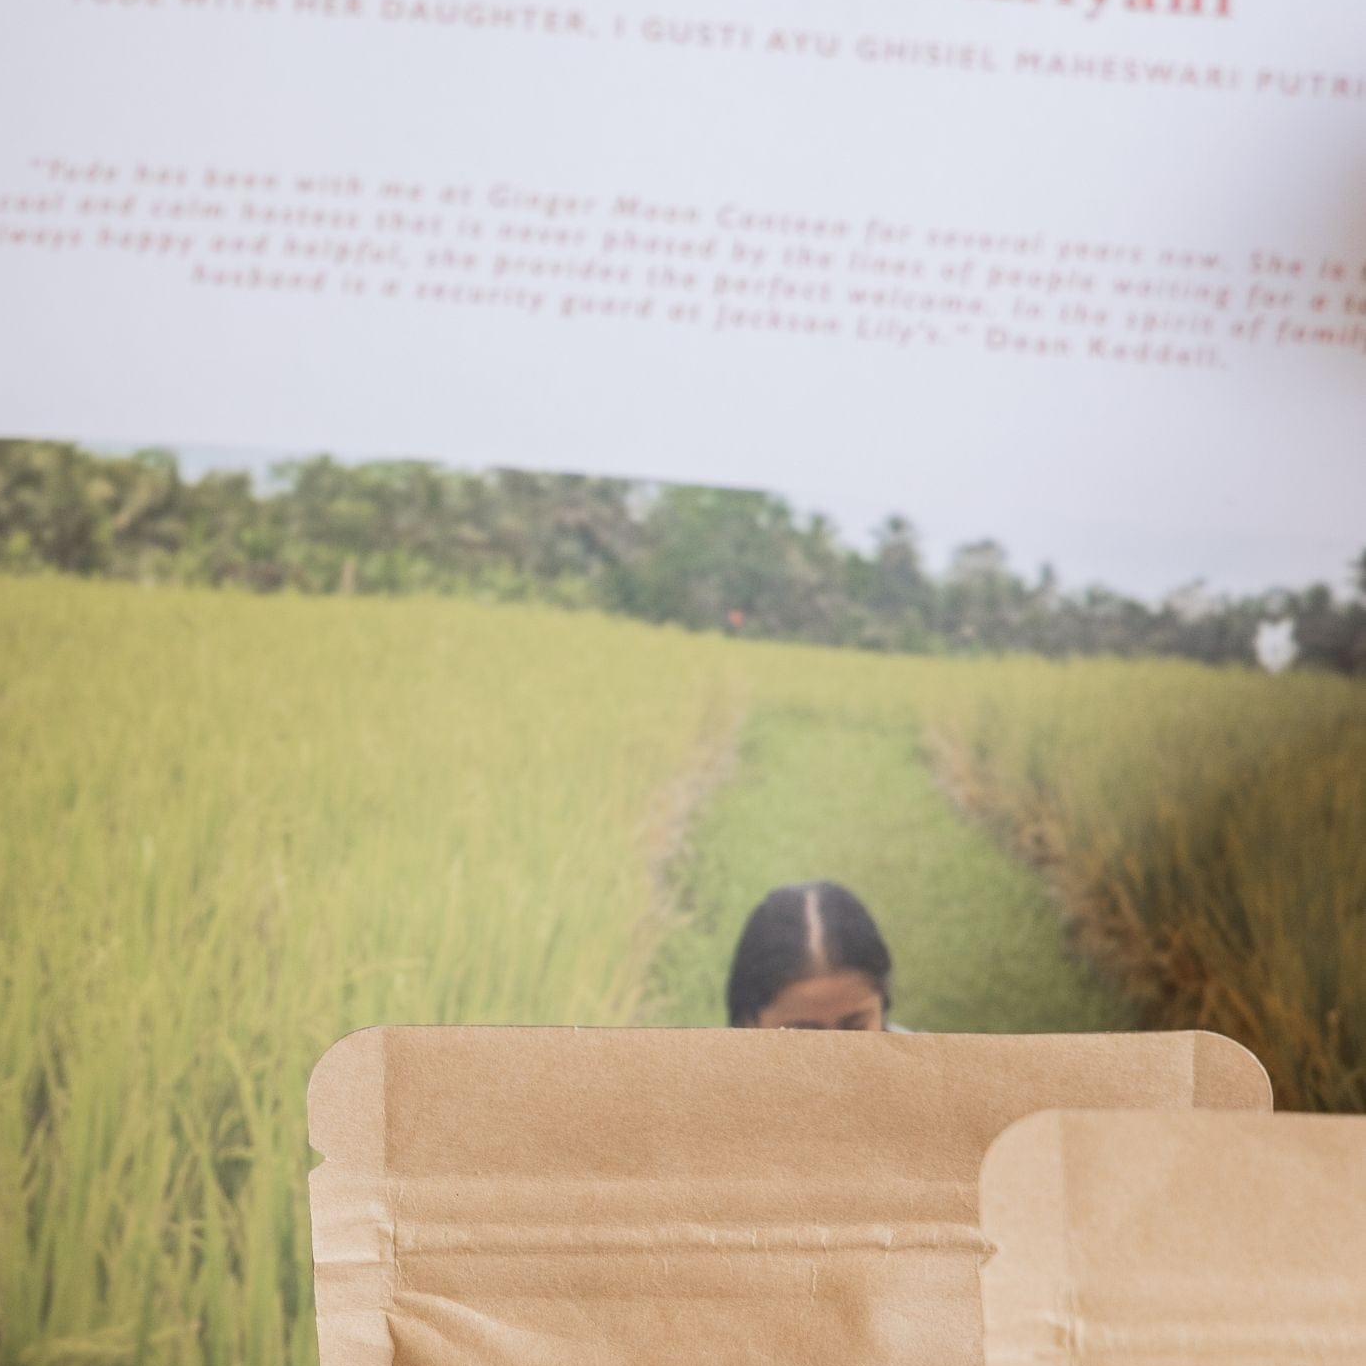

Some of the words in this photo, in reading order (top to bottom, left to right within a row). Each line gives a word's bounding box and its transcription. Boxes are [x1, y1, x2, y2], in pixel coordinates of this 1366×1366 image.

[641, 16, 752, 51] GUSTI
[765, 28, 840, 59] AYU
[1017, 50, 1240, 92] MAHESWARI
[296, 174, 363, 196] with
[77, 196, 135, 217] and
[209, 234, 270, 256] and
